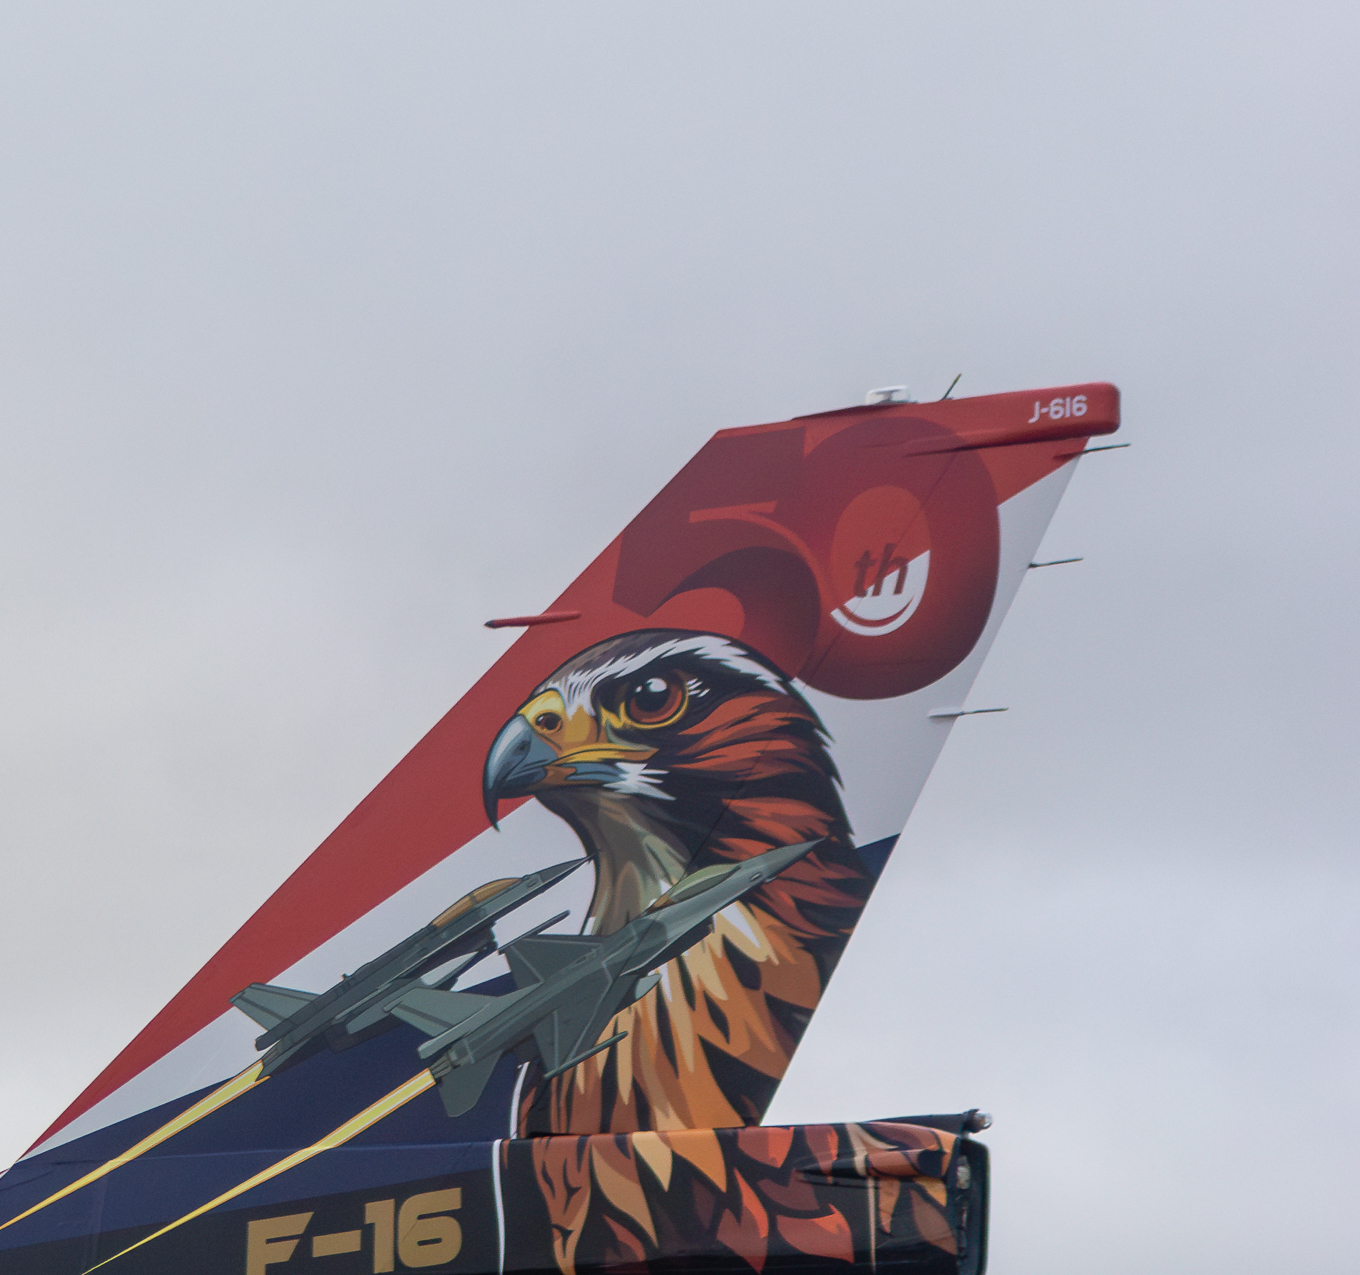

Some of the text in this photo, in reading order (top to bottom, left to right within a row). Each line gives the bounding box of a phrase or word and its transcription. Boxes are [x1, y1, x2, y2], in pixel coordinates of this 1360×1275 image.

[1028, 395, 1088, 424] J-616
[612, 415, 1001, 700] 50 th
